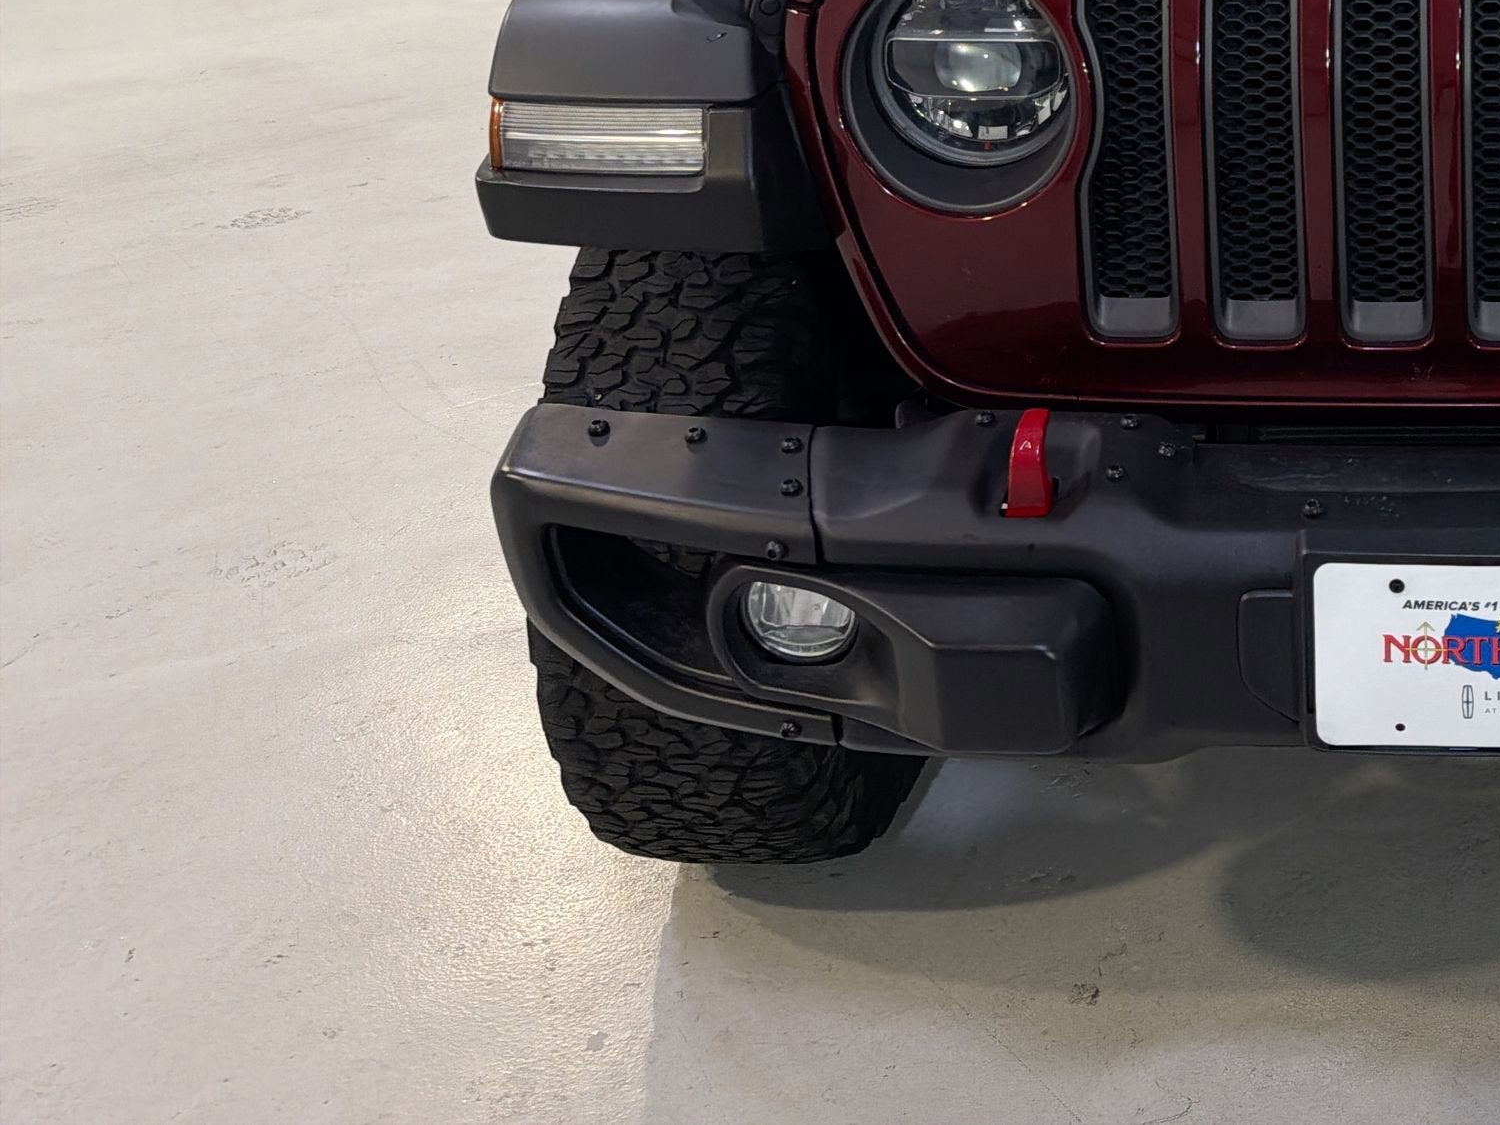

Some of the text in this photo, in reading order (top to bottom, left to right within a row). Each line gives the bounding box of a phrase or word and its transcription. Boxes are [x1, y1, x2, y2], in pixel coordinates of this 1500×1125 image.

[1402, 599, 1481, 612] AMERICA'S
[1484, 600, 1499, 612] #1
[1484, 707, 1497, 715] AT
